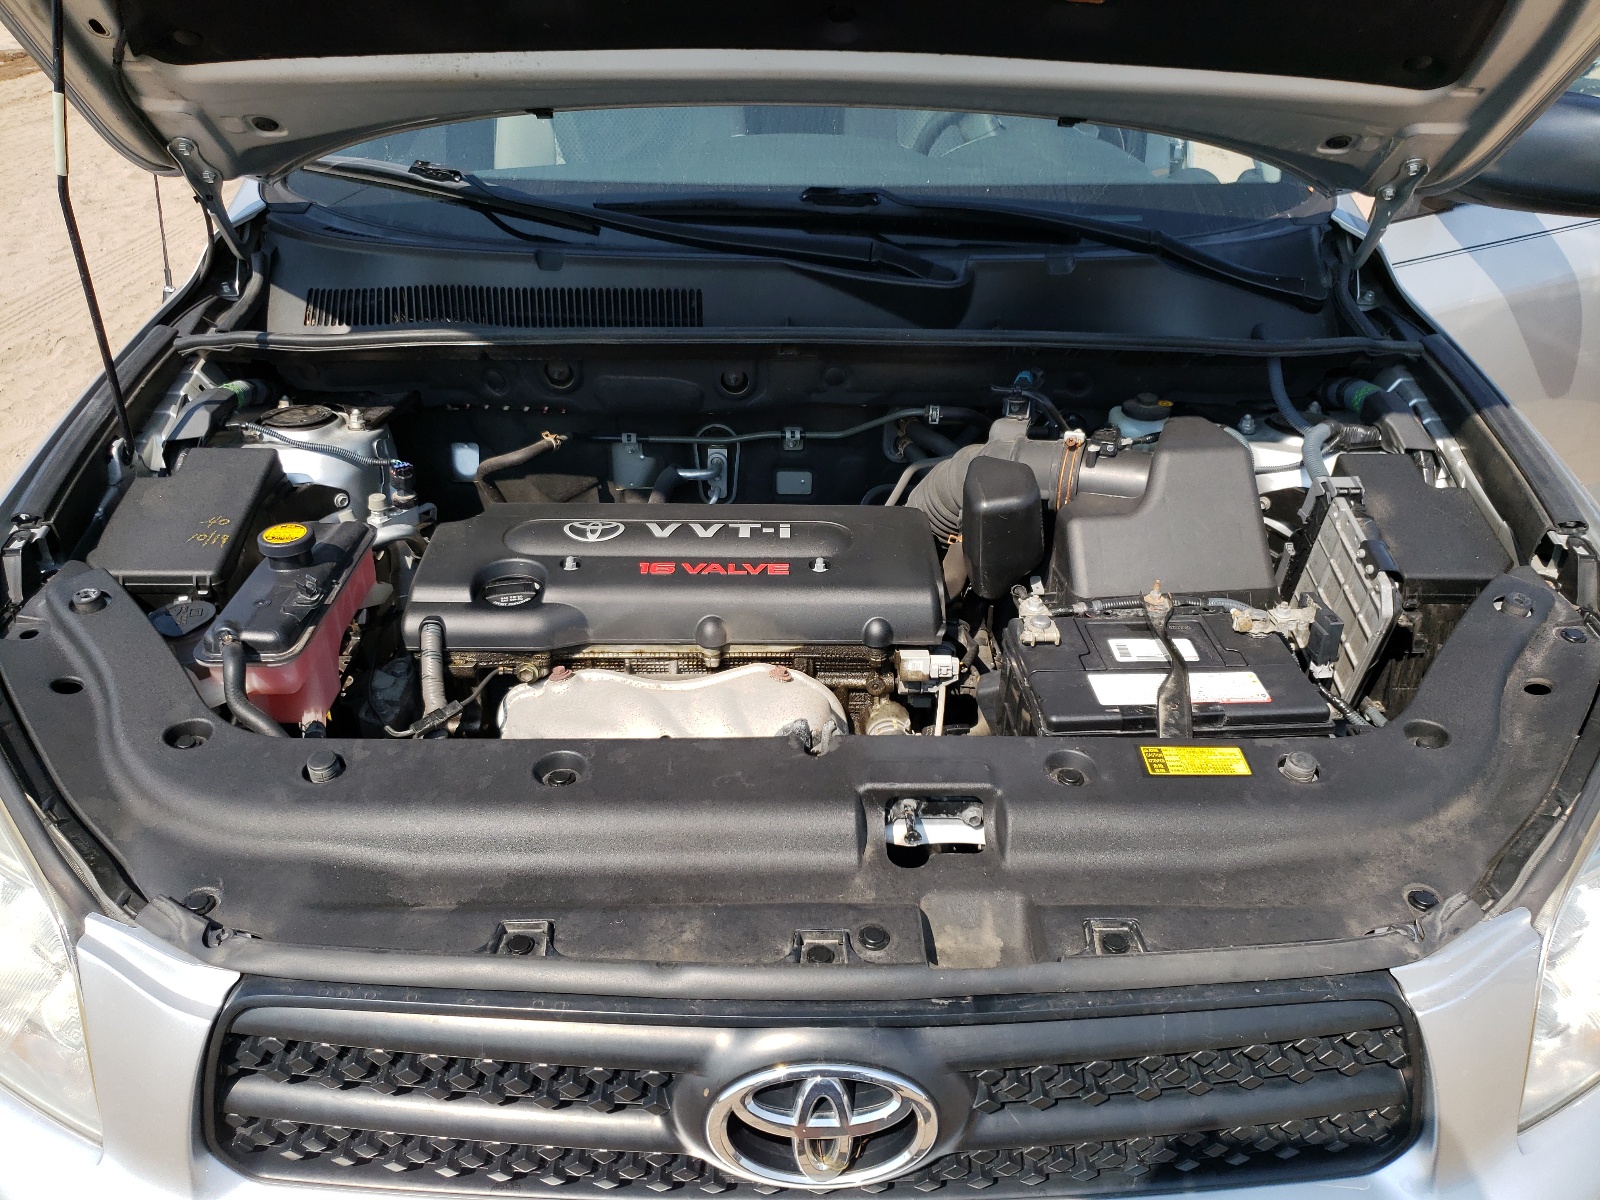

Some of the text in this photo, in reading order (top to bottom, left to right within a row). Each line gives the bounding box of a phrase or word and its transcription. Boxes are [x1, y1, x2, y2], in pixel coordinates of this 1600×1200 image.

[646, 523, 791, 538] VVT-i
[639, 562, 790, 575] 16 VALVE
